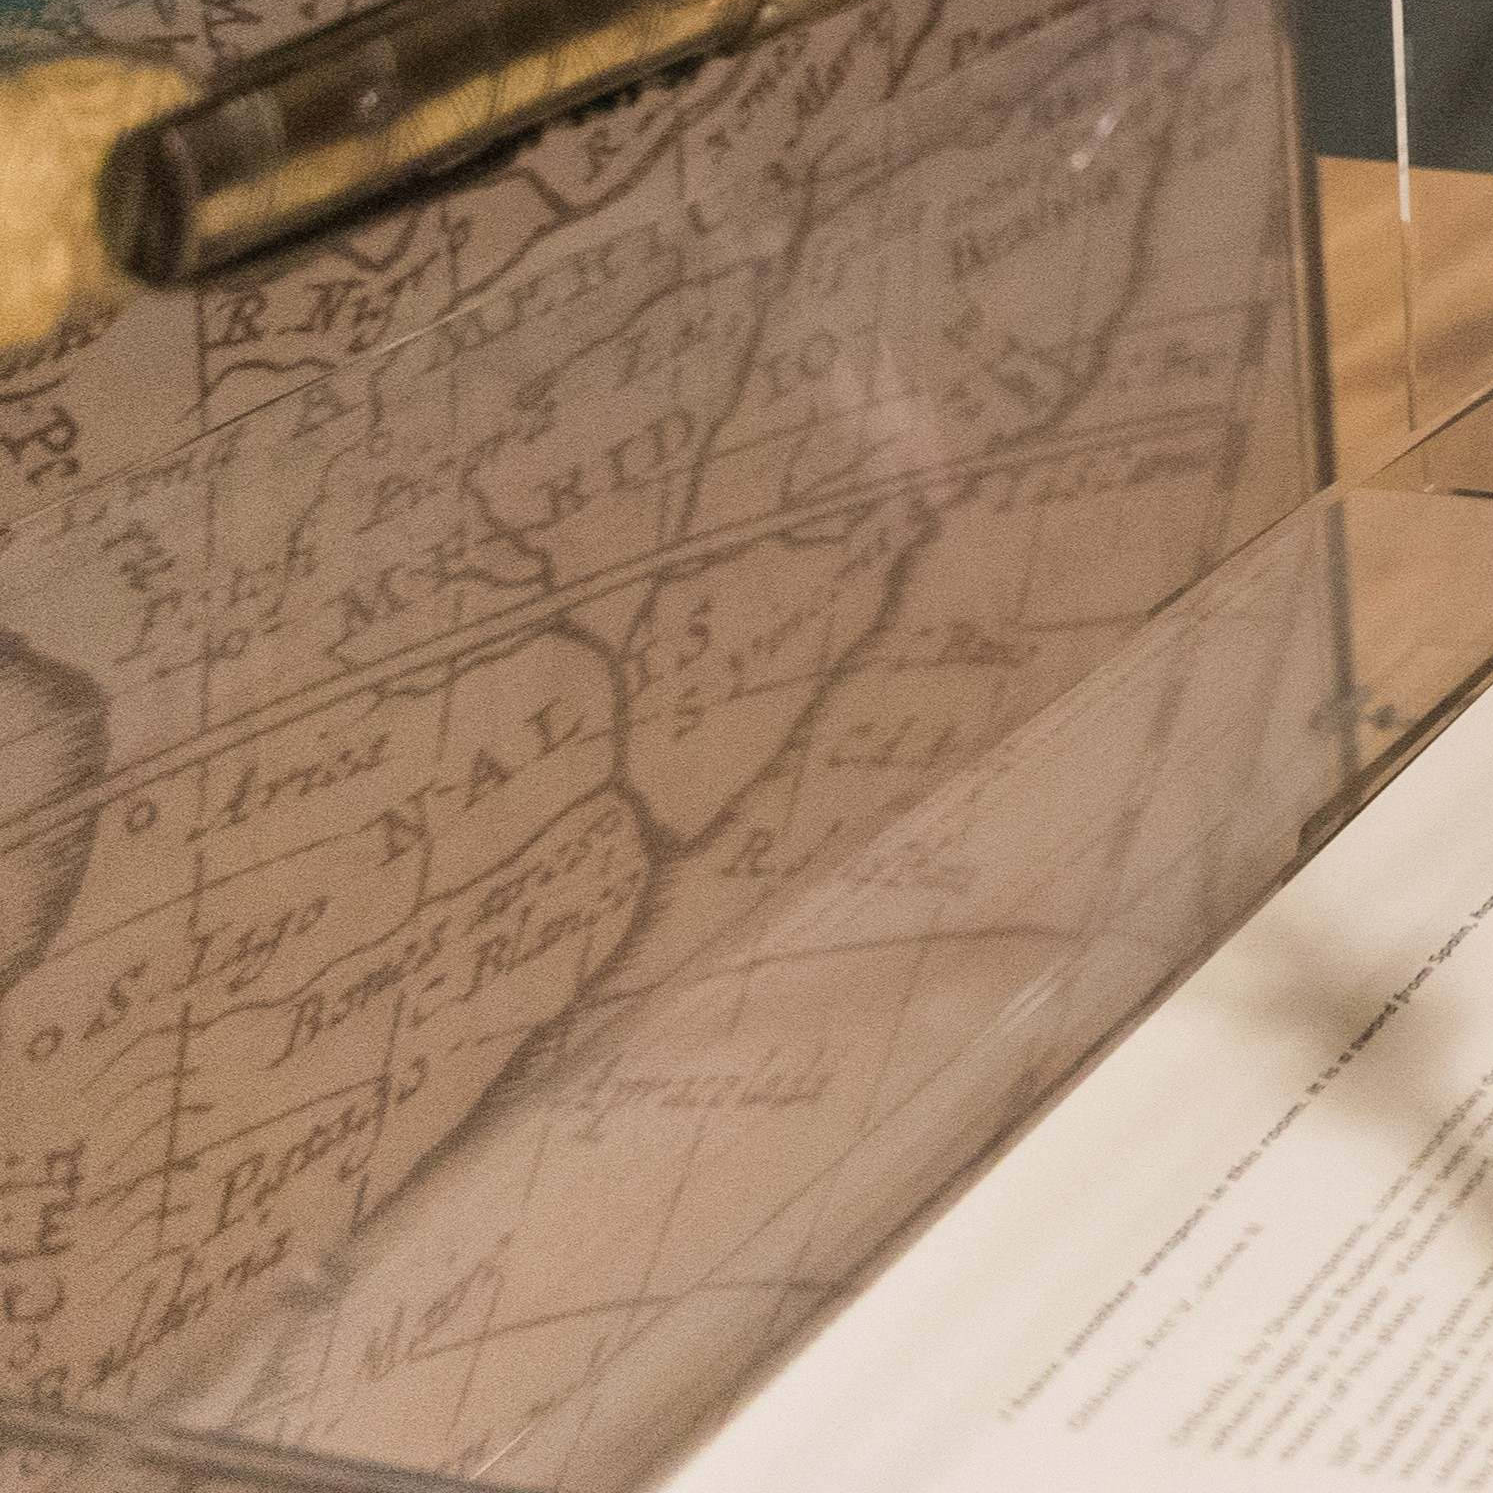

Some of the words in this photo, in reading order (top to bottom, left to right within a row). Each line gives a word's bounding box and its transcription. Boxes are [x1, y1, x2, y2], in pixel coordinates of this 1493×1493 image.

[1219, 1150, 1264, 1181] this
[1343, 1004, 1401, 1050] sword
[1388, 967, 1440, 1003] from
[1425, 921, 1483, 964] Spain,
